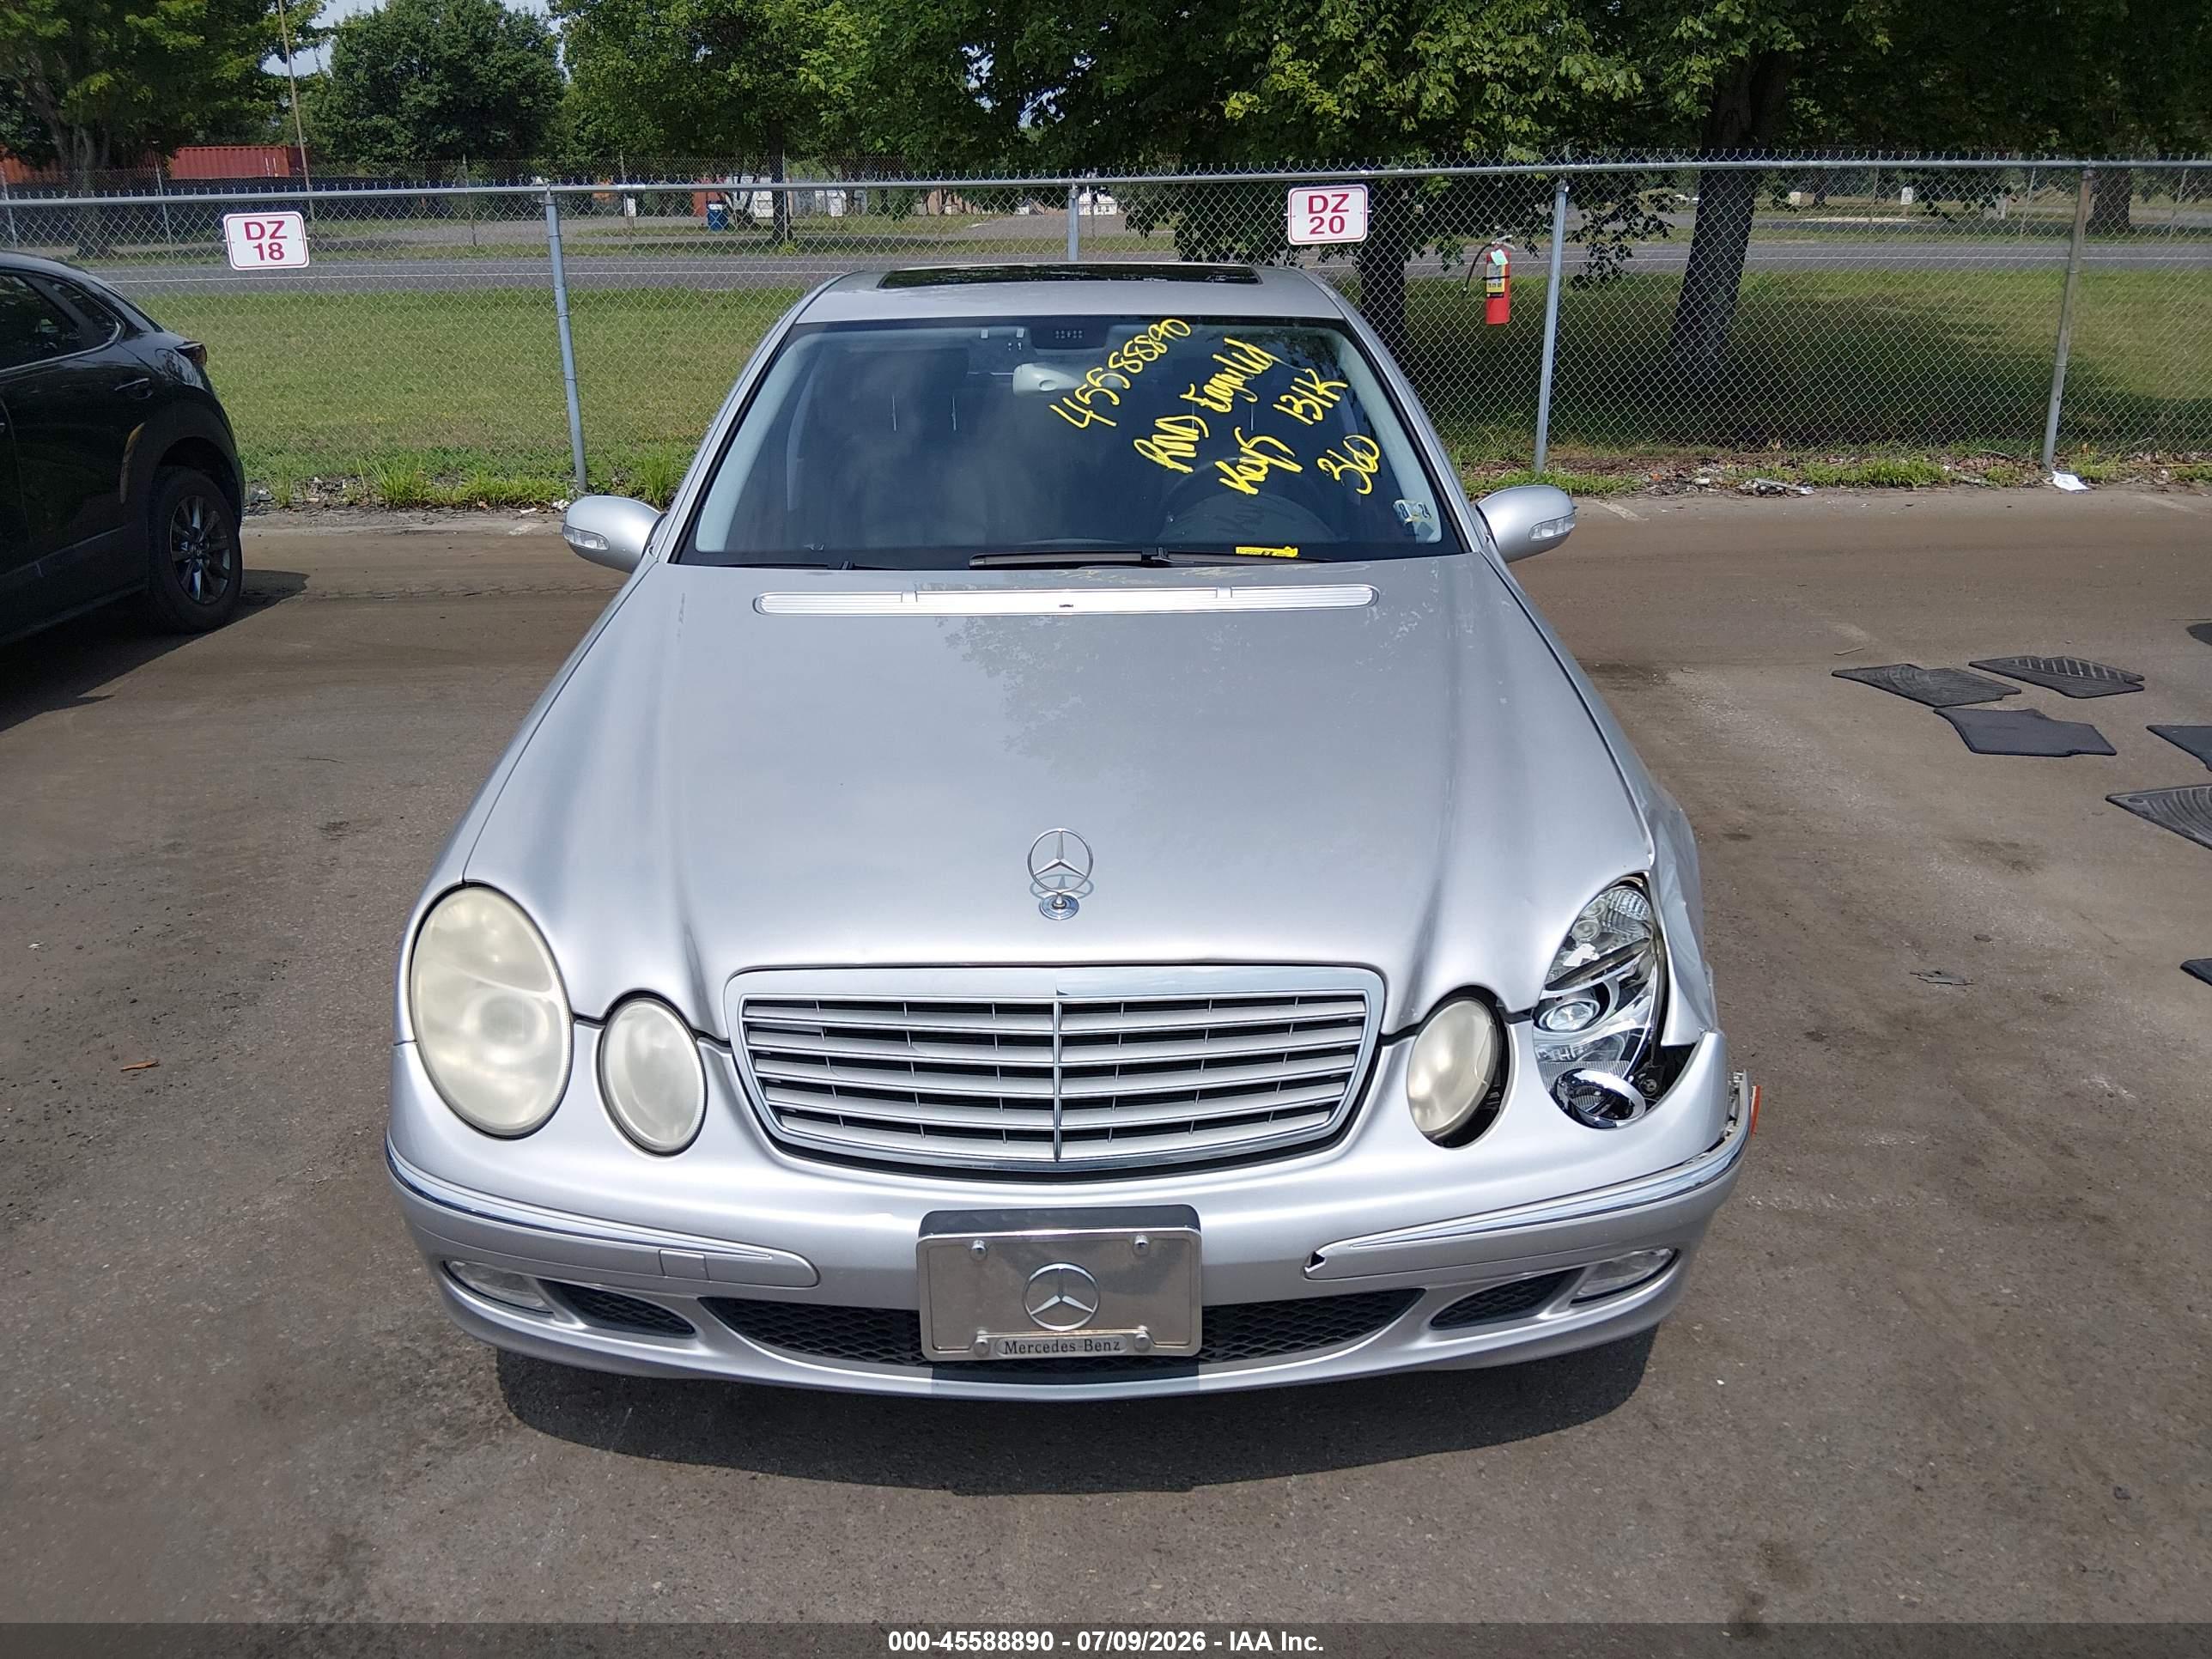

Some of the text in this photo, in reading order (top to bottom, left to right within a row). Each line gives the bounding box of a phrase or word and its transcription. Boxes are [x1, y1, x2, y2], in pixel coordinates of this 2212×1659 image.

[1308, 193, 1349, 215] DZ
[244, 220, 288, 240] DZ
[1309, 216, 1346, 234] 20
[252, 242, 284, 261] 18
[1049, 319, 1191, 428] 45588890
[1004, 1339, 1121, 1355] Mercedes Benz
